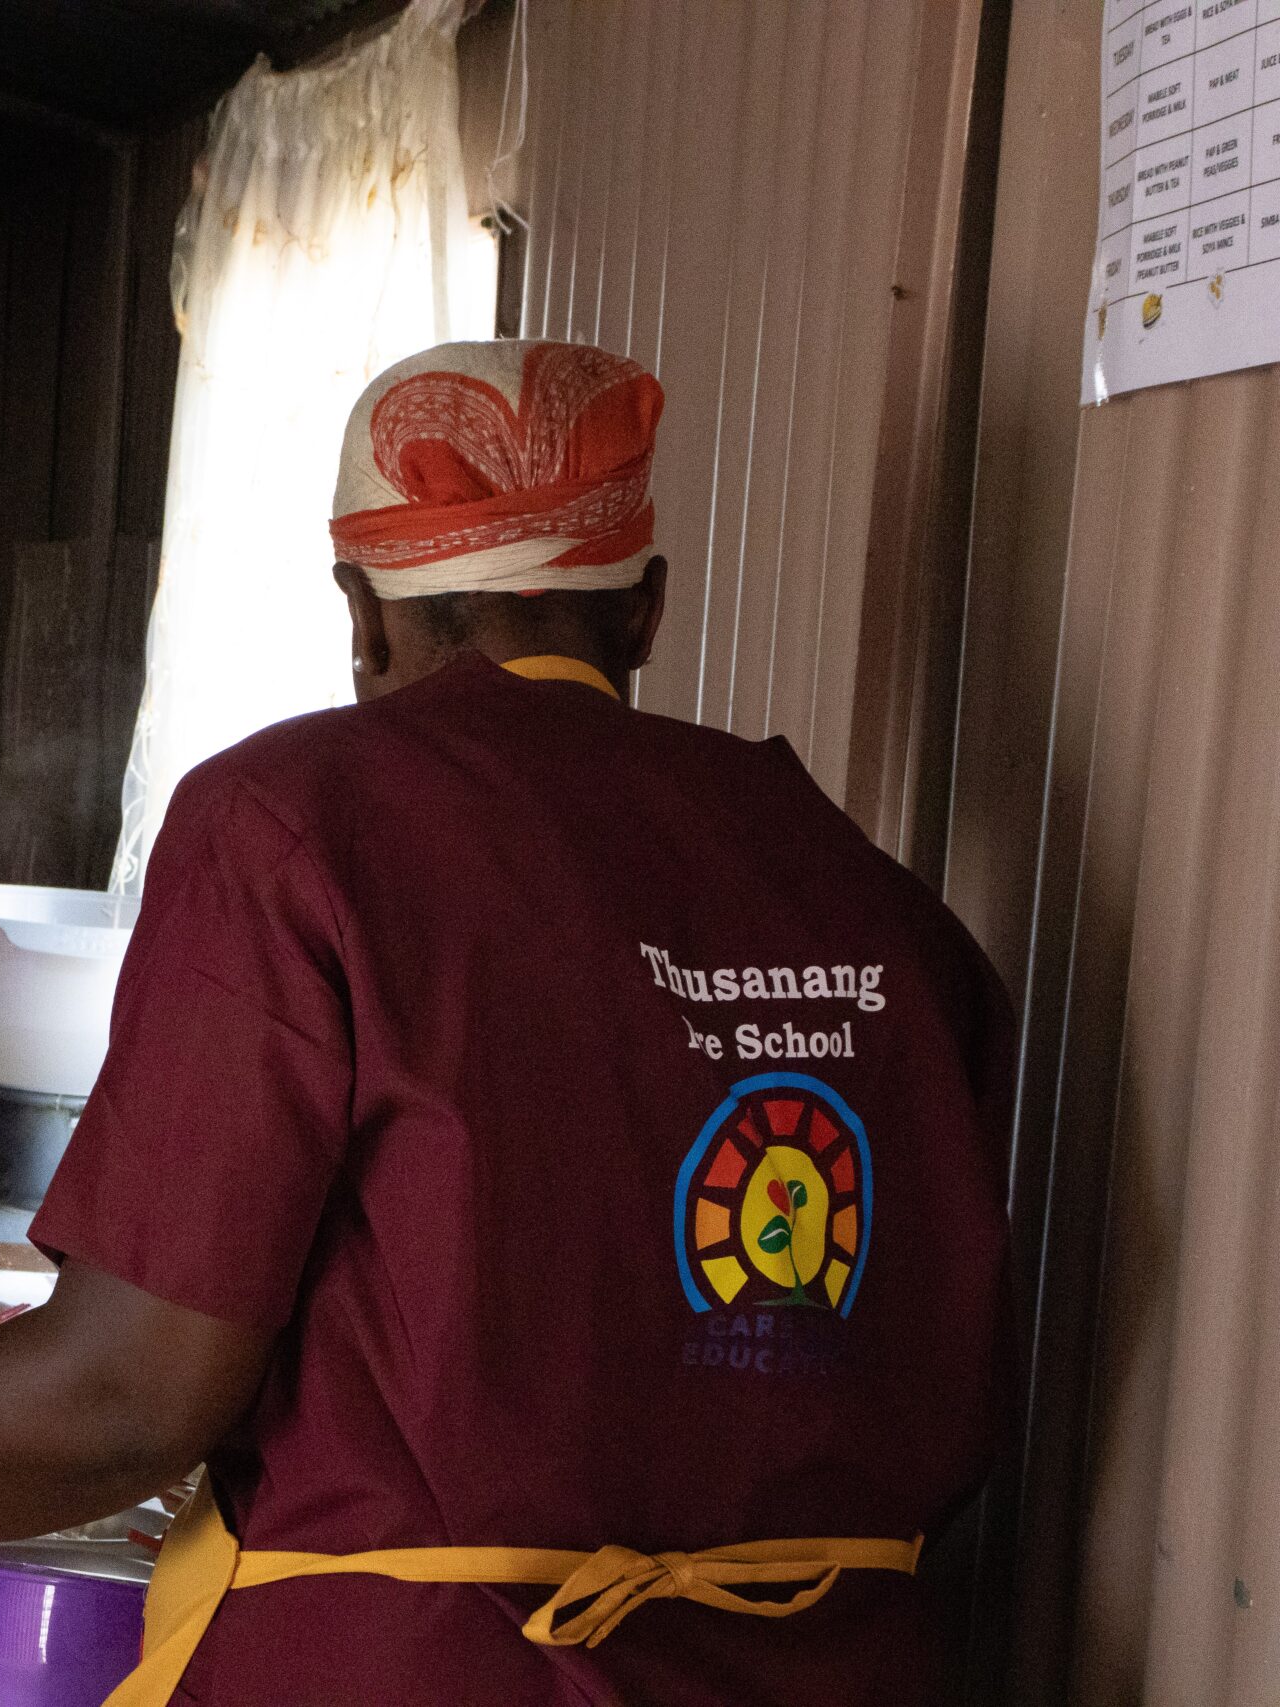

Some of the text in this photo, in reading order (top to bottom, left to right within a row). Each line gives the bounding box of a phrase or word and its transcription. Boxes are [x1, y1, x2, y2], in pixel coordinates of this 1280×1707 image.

[640, 941, 885, 1012] Thusanang
[682, 1015, 855, 1060] re School
